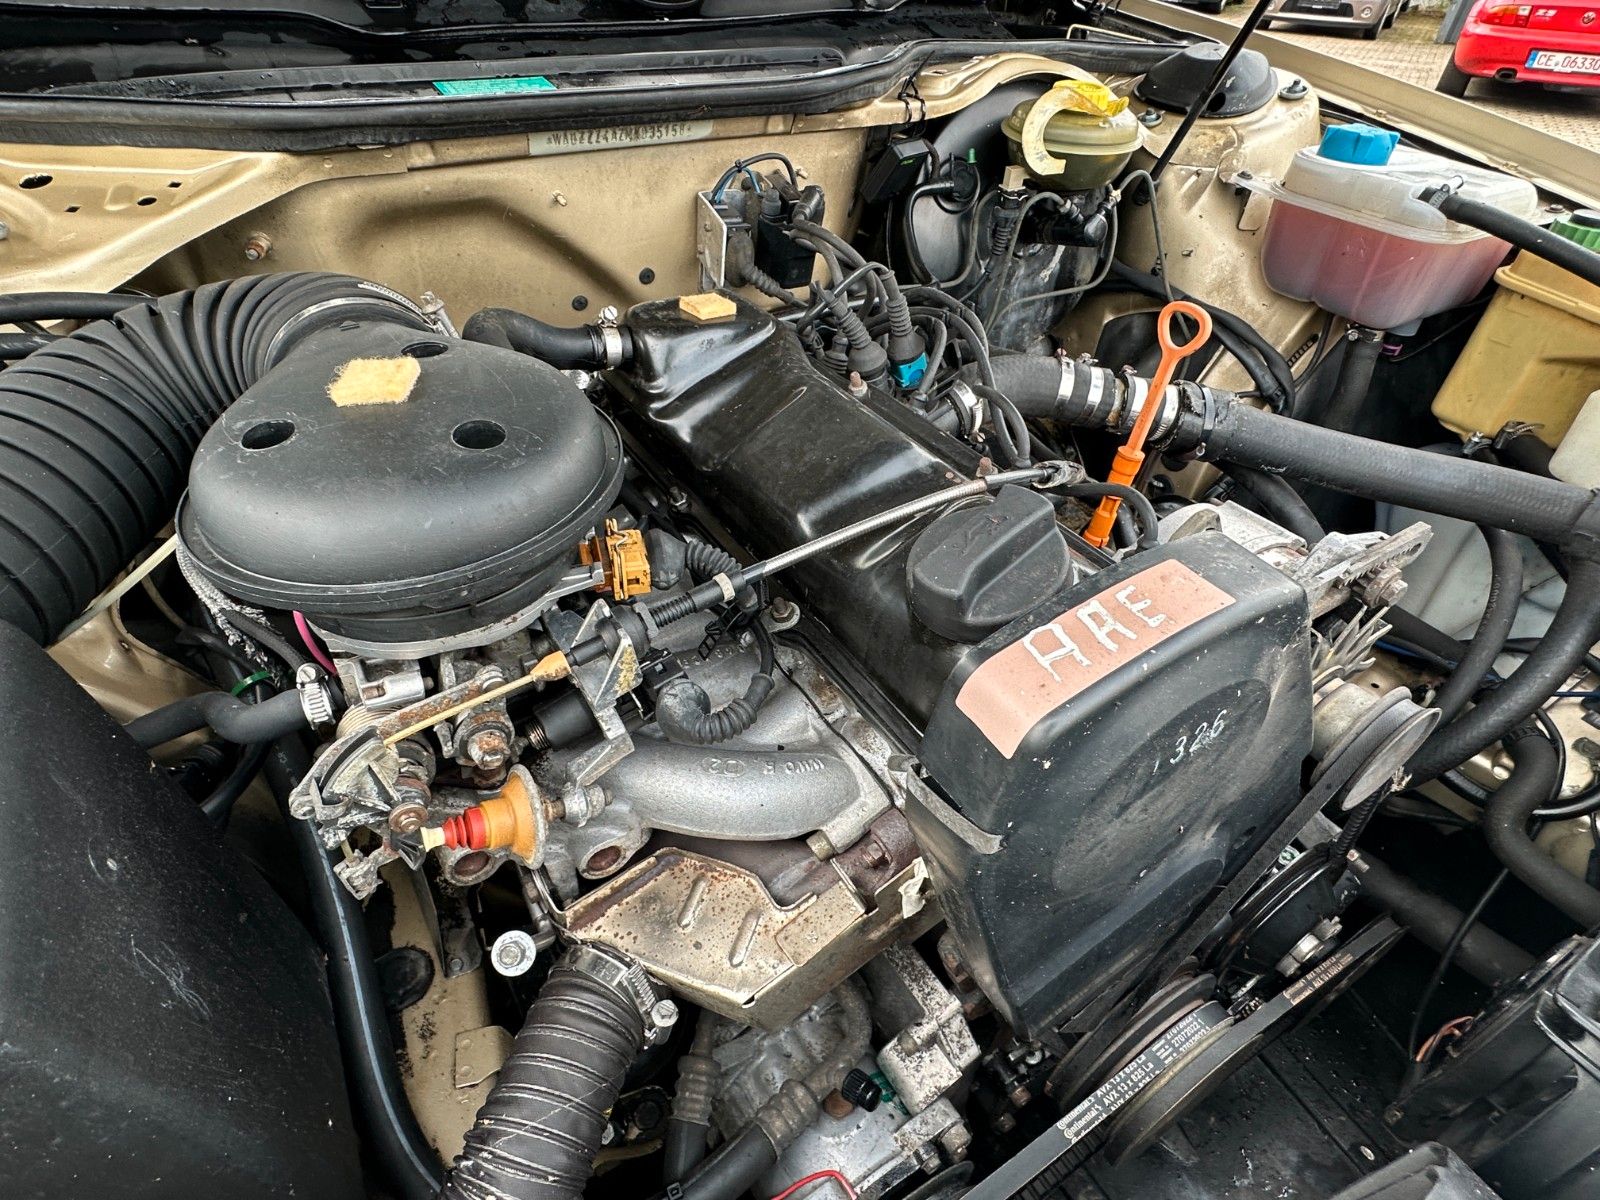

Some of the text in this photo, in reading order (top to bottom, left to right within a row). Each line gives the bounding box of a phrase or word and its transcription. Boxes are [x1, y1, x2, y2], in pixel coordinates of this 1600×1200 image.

[1537, 53, 1556, 66] CE
[1102, 1088, 1120, 1107] AVX
[1117, 1080, 1128, 1093] 13
[1130, 1067, 1146, 1082] 825
[1142, 1061, 1154, 1072] La
